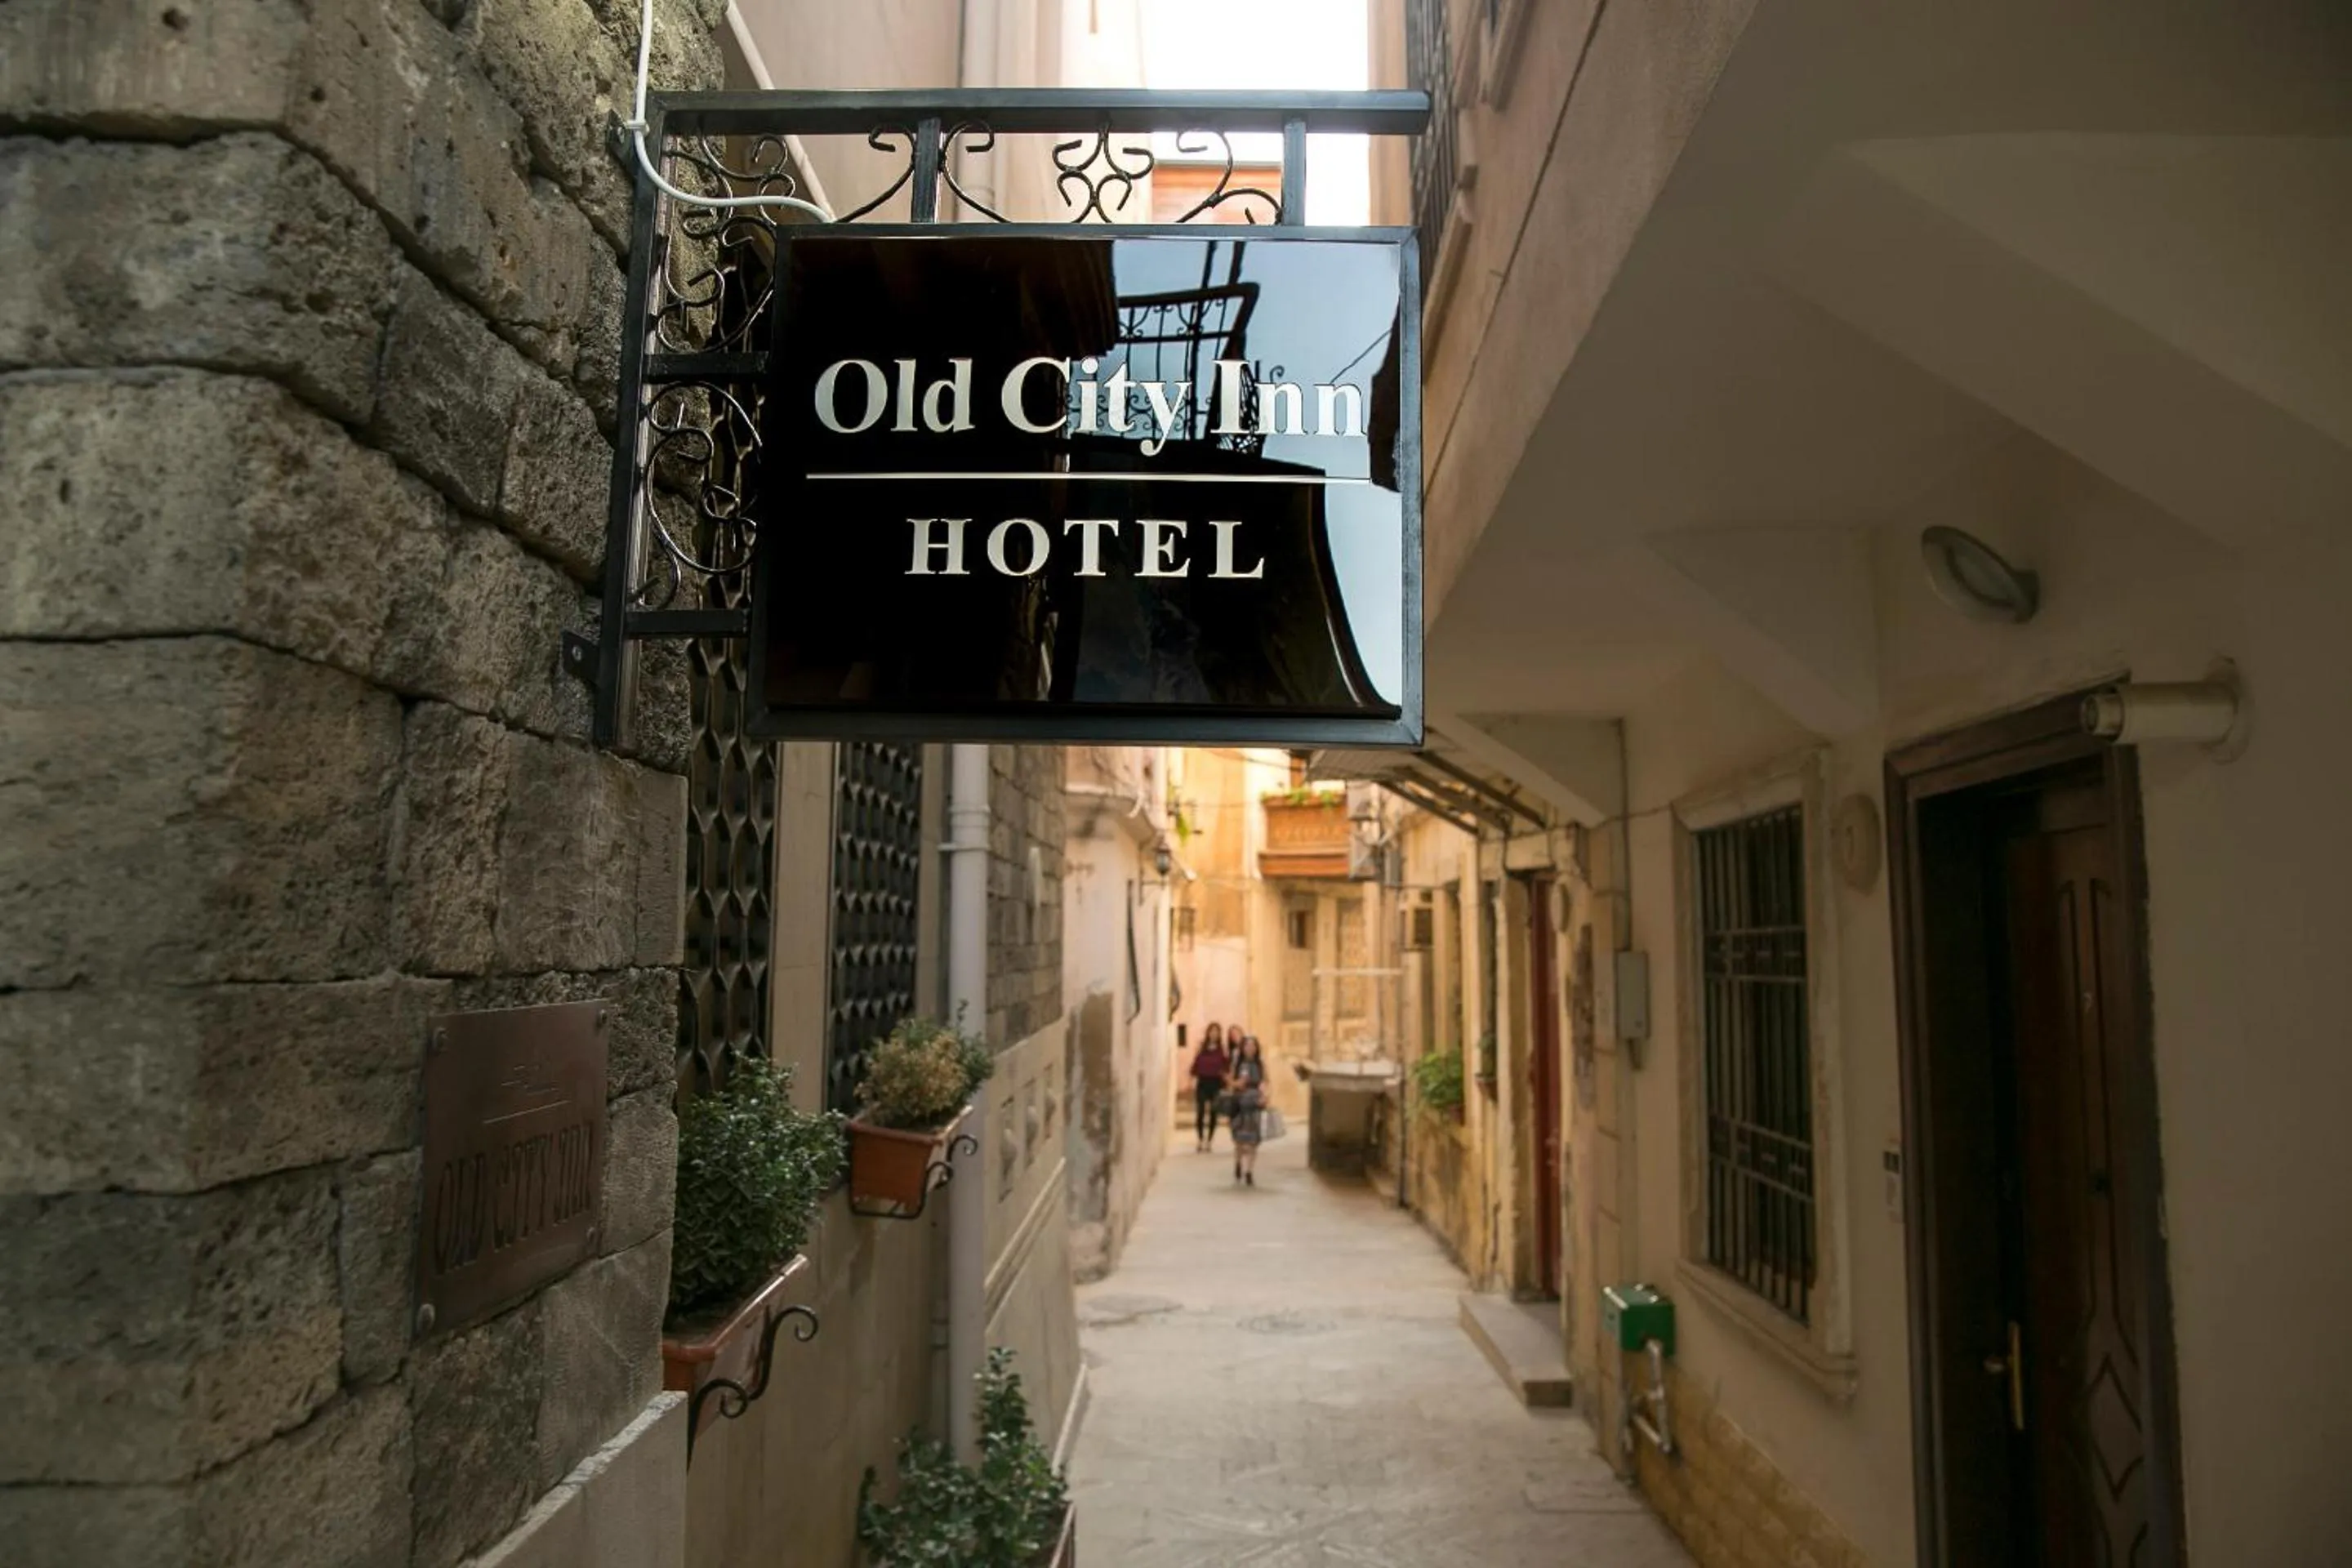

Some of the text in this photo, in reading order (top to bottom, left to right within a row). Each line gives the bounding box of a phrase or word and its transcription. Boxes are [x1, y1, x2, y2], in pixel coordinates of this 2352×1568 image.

[814, 357, 1369, 457] Old City Inn
[904, 518, 1265, 579] HOTEL
